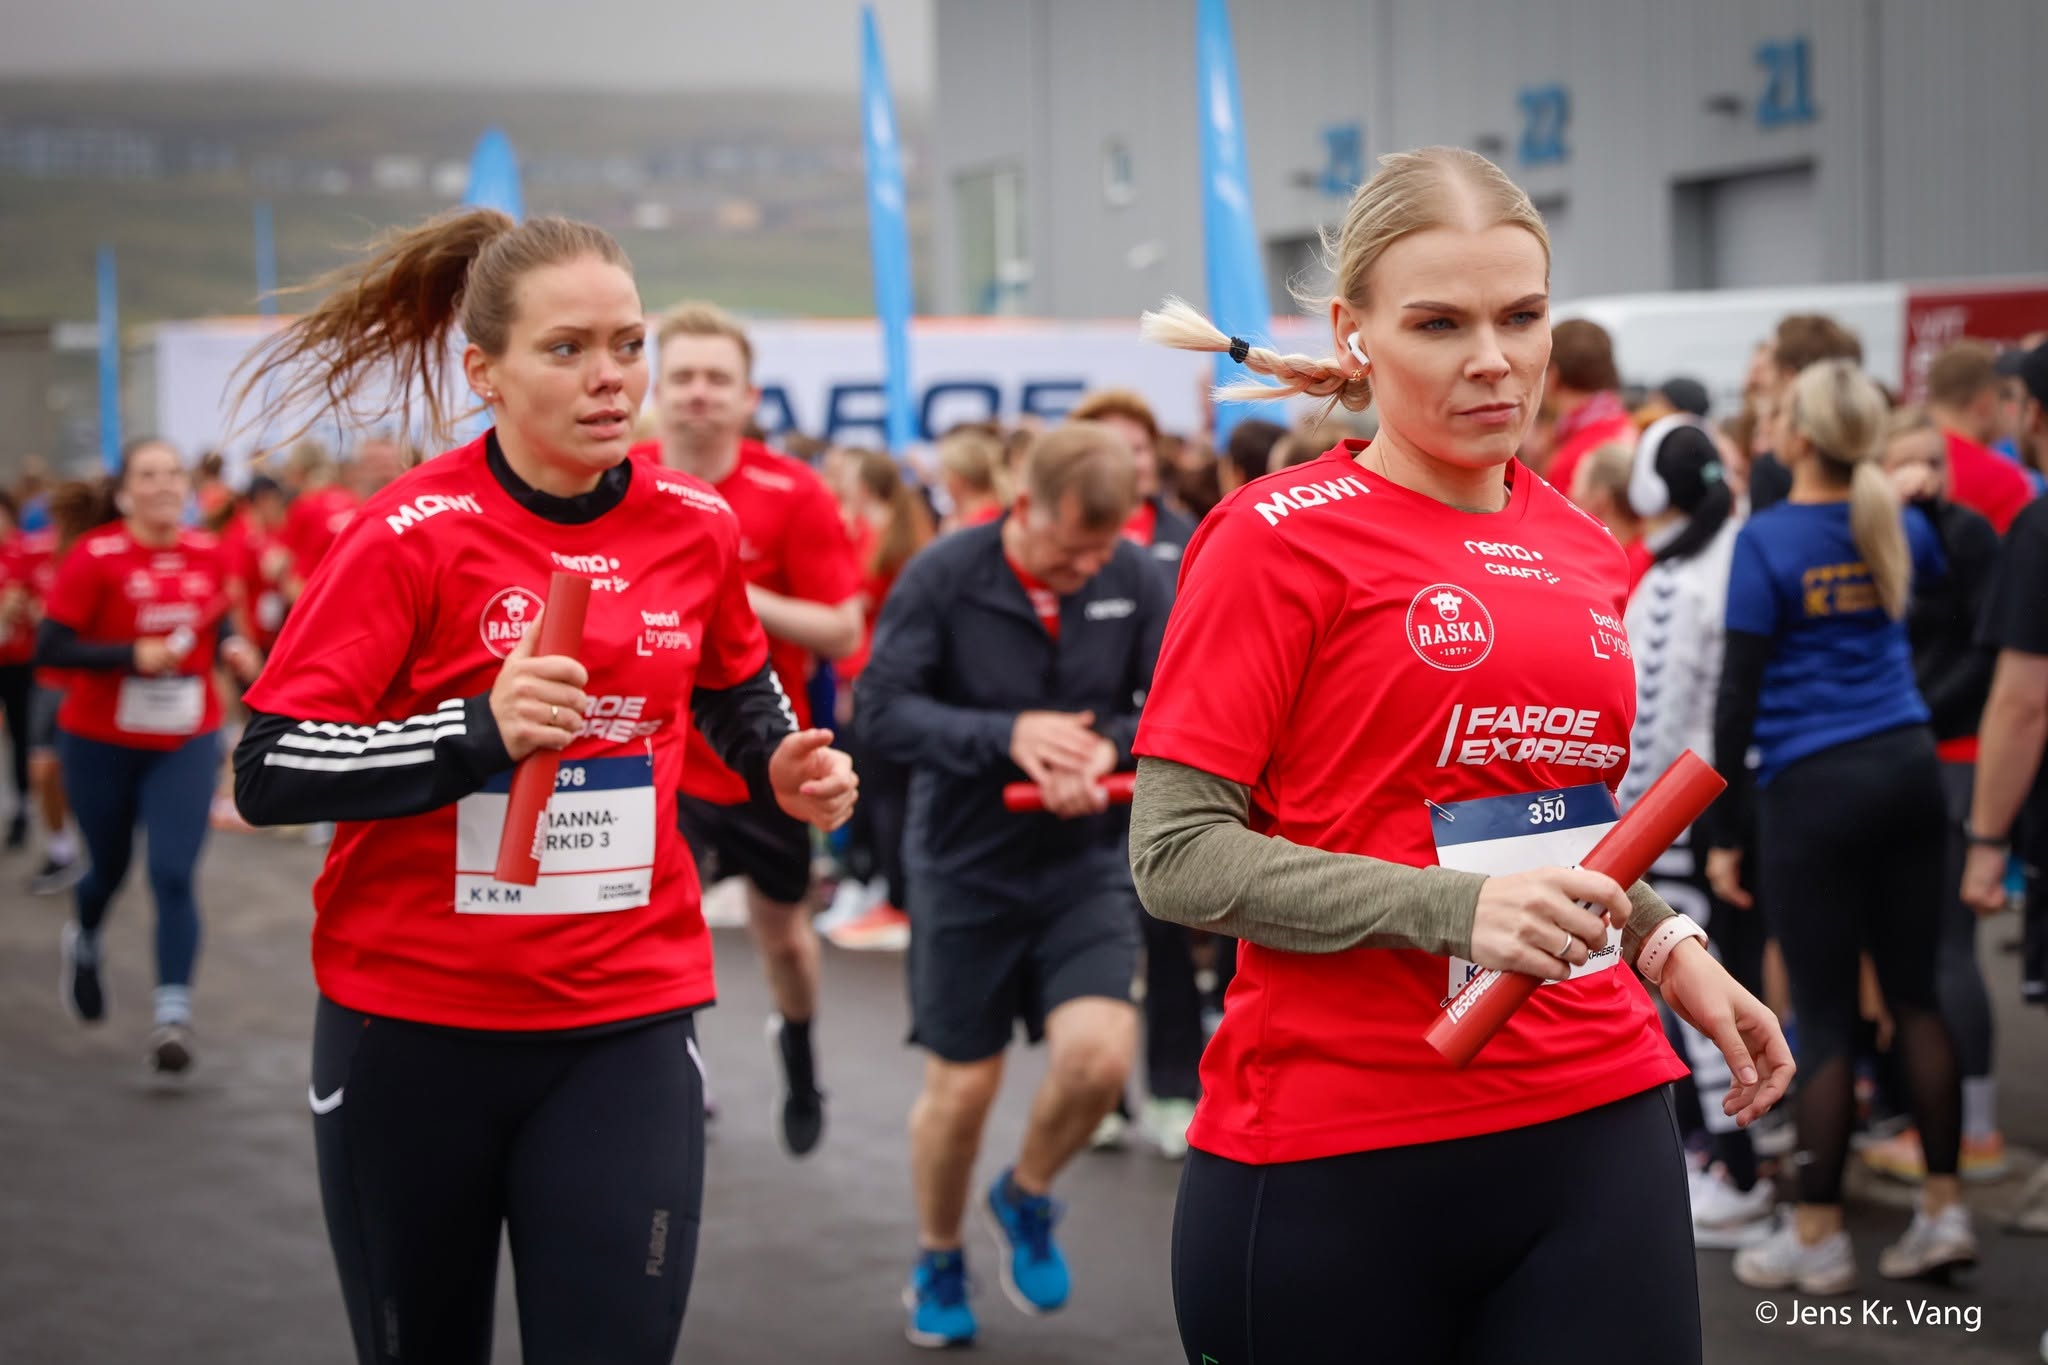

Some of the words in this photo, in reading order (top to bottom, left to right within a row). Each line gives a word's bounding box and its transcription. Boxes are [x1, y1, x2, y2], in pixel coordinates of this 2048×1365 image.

[1756, 40, 1816, 126] 21
[1517, 84, 1570, 165] 22
[1485, 563, 1541, 580] CRAFT
[1418, 621, 1487, 647] RASKA
[1444, 646, 1468, 656] 1977
[1466, 706, 1600, 737] FAROE
[1456, 737, 1626, 768] EXPRESS
[554, 767, 586, 787] 98
[1528, 799, 1566, 825] 350
[600, 832, 611, 848] 3
[470, 887, 482, 902] K
[487, 888, 500, 902] K
[504, 889, 522, 902] M
